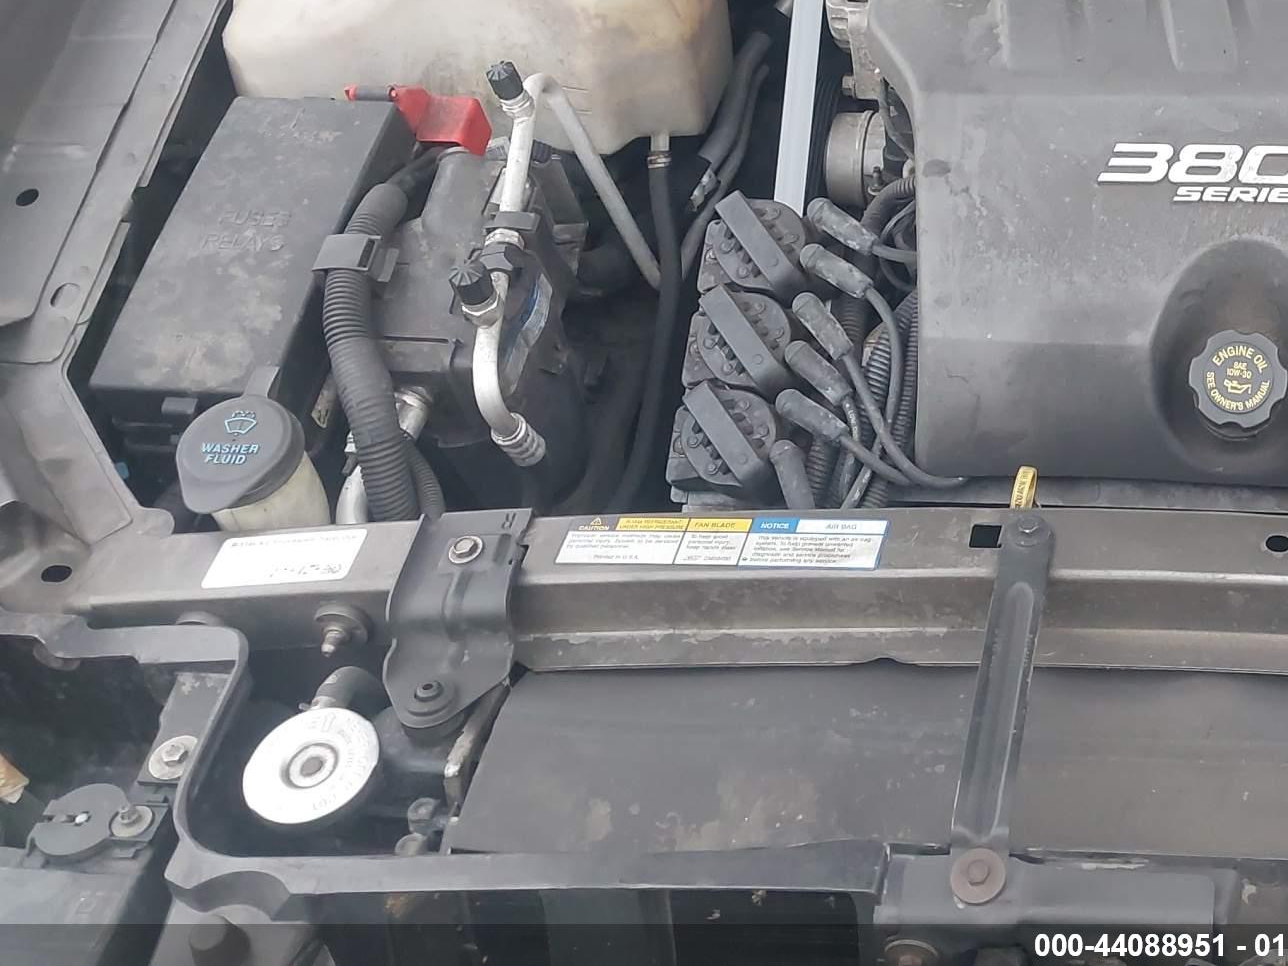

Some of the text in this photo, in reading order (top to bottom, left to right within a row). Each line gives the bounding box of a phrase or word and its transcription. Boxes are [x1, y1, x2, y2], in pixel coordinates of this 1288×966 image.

[217, 209, 292, 227] FUSES
[200, 234, 285, 252] RELAYS
[1211, 345, 1269, 374] ENGINE OIL
[1233, 361, 1248, 370] SAE
[1226, 367, 1253, 380] 10W-30
[1206, 371, 1271, 411] SEE OWNER'S MANUAL
[201, 442, 260, 454] WASHER
[204, 453, 247, 465] FLUID
[760, 522, 790, 530] NOTICE
